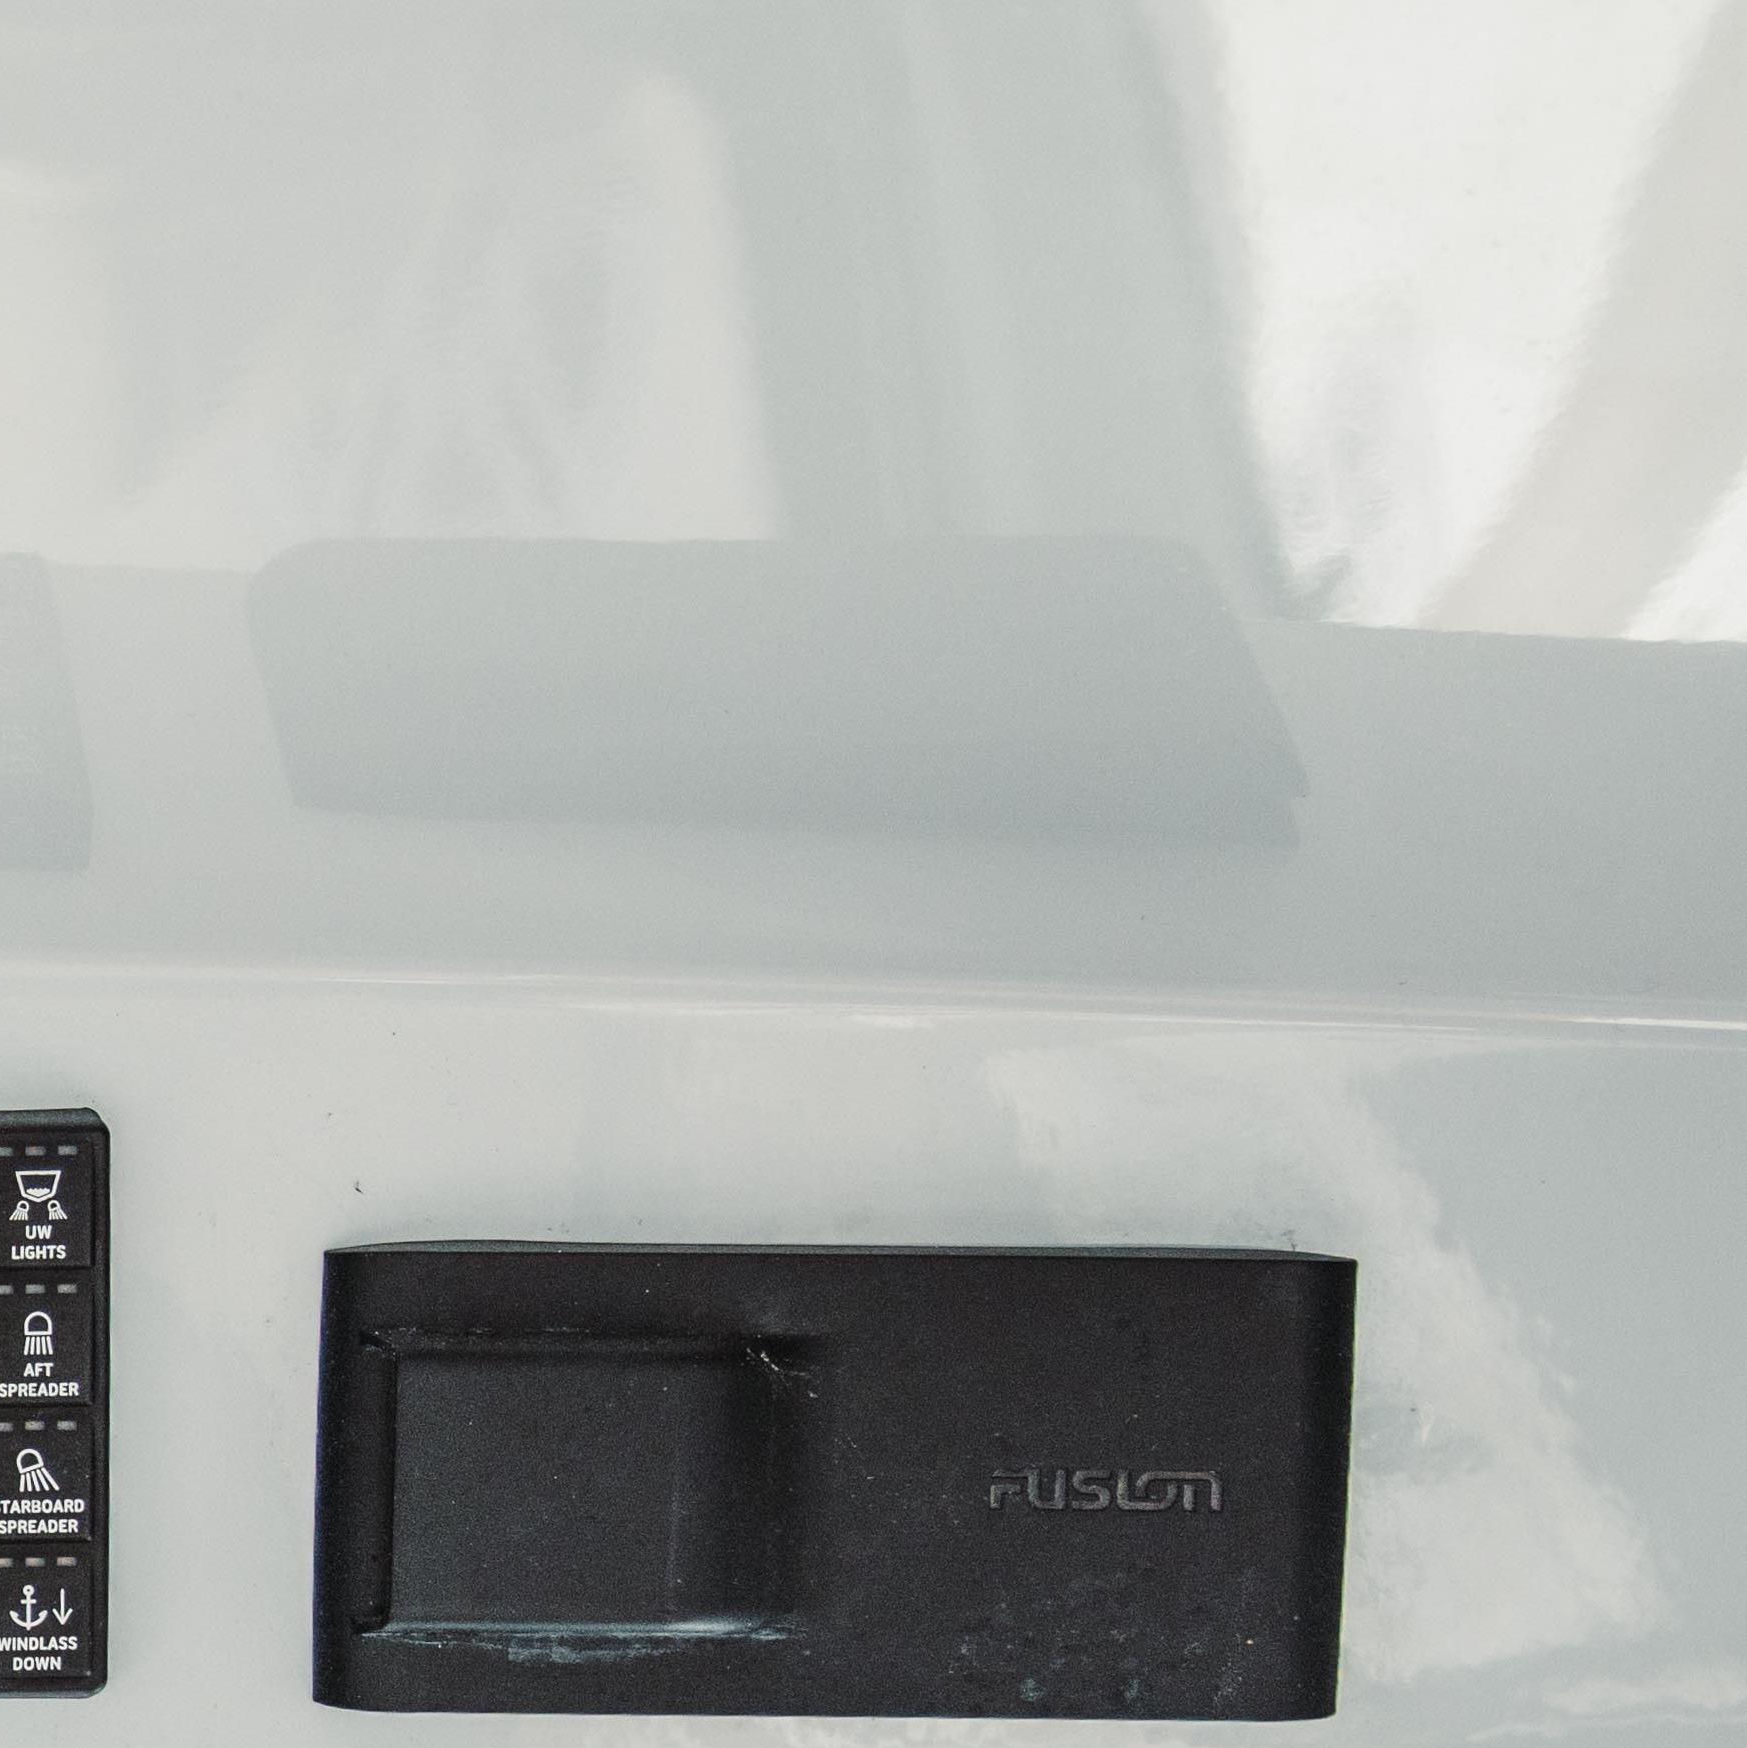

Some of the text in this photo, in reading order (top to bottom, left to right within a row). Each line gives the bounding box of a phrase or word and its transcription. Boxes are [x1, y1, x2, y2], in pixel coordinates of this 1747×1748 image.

[25, 1224, 53, 1240] UW
[11, 1244, 67, 1261] LIGHTS
[23, 1362, 55, 1378] AFT
[990, 1468, 1222, 1511] FUSION
[12, 1655, 62, 1672] DOWN
